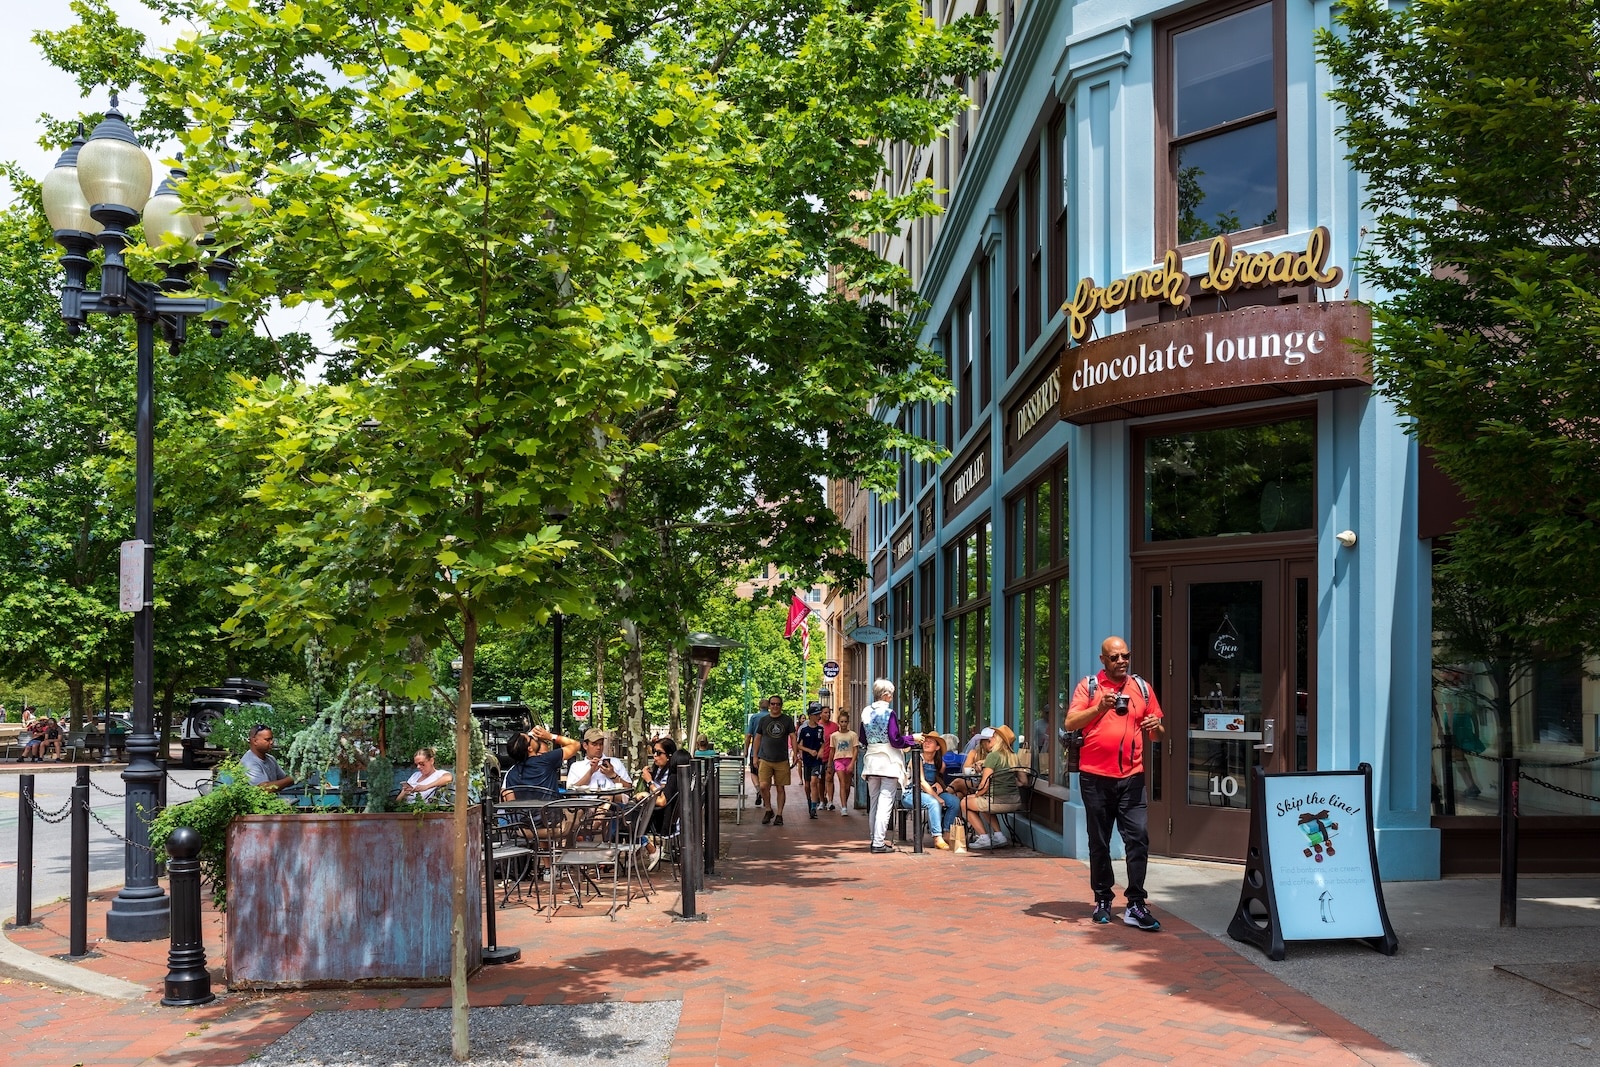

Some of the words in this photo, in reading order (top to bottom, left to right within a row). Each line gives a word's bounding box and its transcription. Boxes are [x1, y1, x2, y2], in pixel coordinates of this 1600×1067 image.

[1061, 249, 1189, 341] french
[1200, 226, 1340, 292] broad
[1071, 340, 1194, 392] chocolate
[1204, 329, 1326, 366] lounge
[1017, 366, 1060, 441] DESSERTS
[953, 452, 985, 505] CHOCOLATE
[1213, 639, 1238, 654] Open
[1210, 775, 1238, 797] 10
[1276, 797, 1303, 817] Skip
[1306, 791, 1326, 805] the
[1328, 794, 1361, 816] line!
